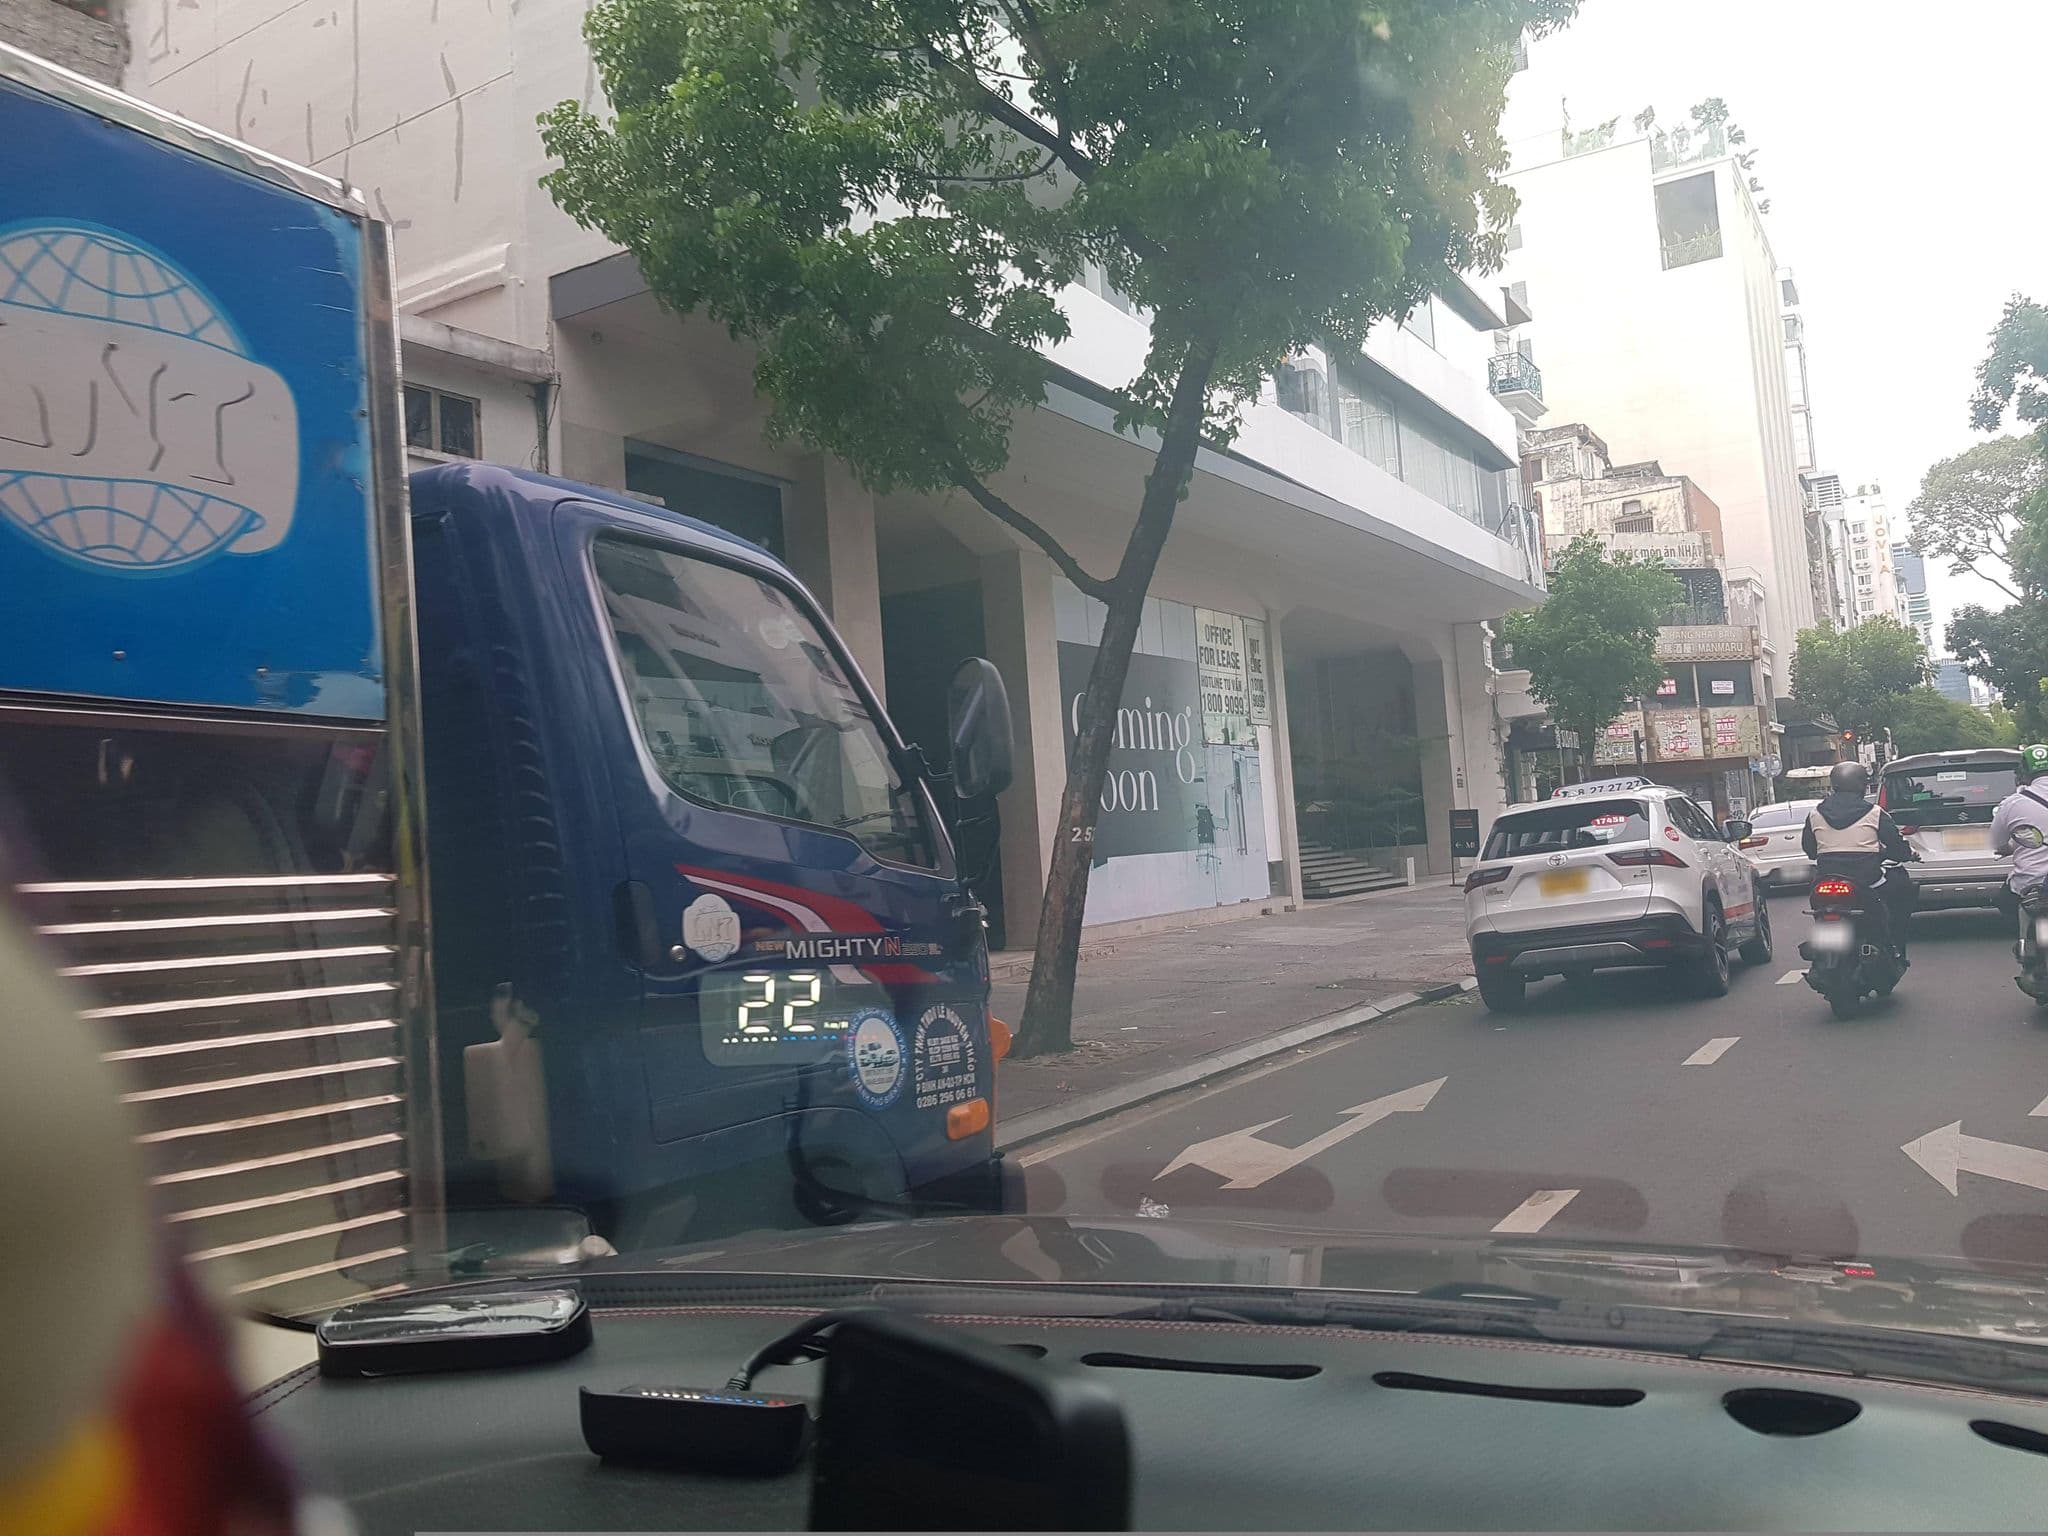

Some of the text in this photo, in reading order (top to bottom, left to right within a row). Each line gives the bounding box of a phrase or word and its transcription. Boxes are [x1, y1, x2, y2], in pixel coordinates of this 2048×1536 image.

[1664, 545, 1676, 558] ăn
[1875, 515, 1890, 574] JOVIA
[1204, 624, 1232, 647] OFFICE
[1199, 646, 1241, 670] FOR LEASE
[1698, 641, 1743, 654] MANMARU
[1201, 674, 1223, 690] HOTLINE
[1202, 692, 1245, 715] 1800 9099
[1590, 785, 1604, 794] 27
[1608, 783, 1622, 792] 27
[1626, 780, 1641, 789] 27
[755, 940, 784, 951] NEW
[786, 937, 884, 959] MIGHTY
[737, 974, 821, 1033] 22
